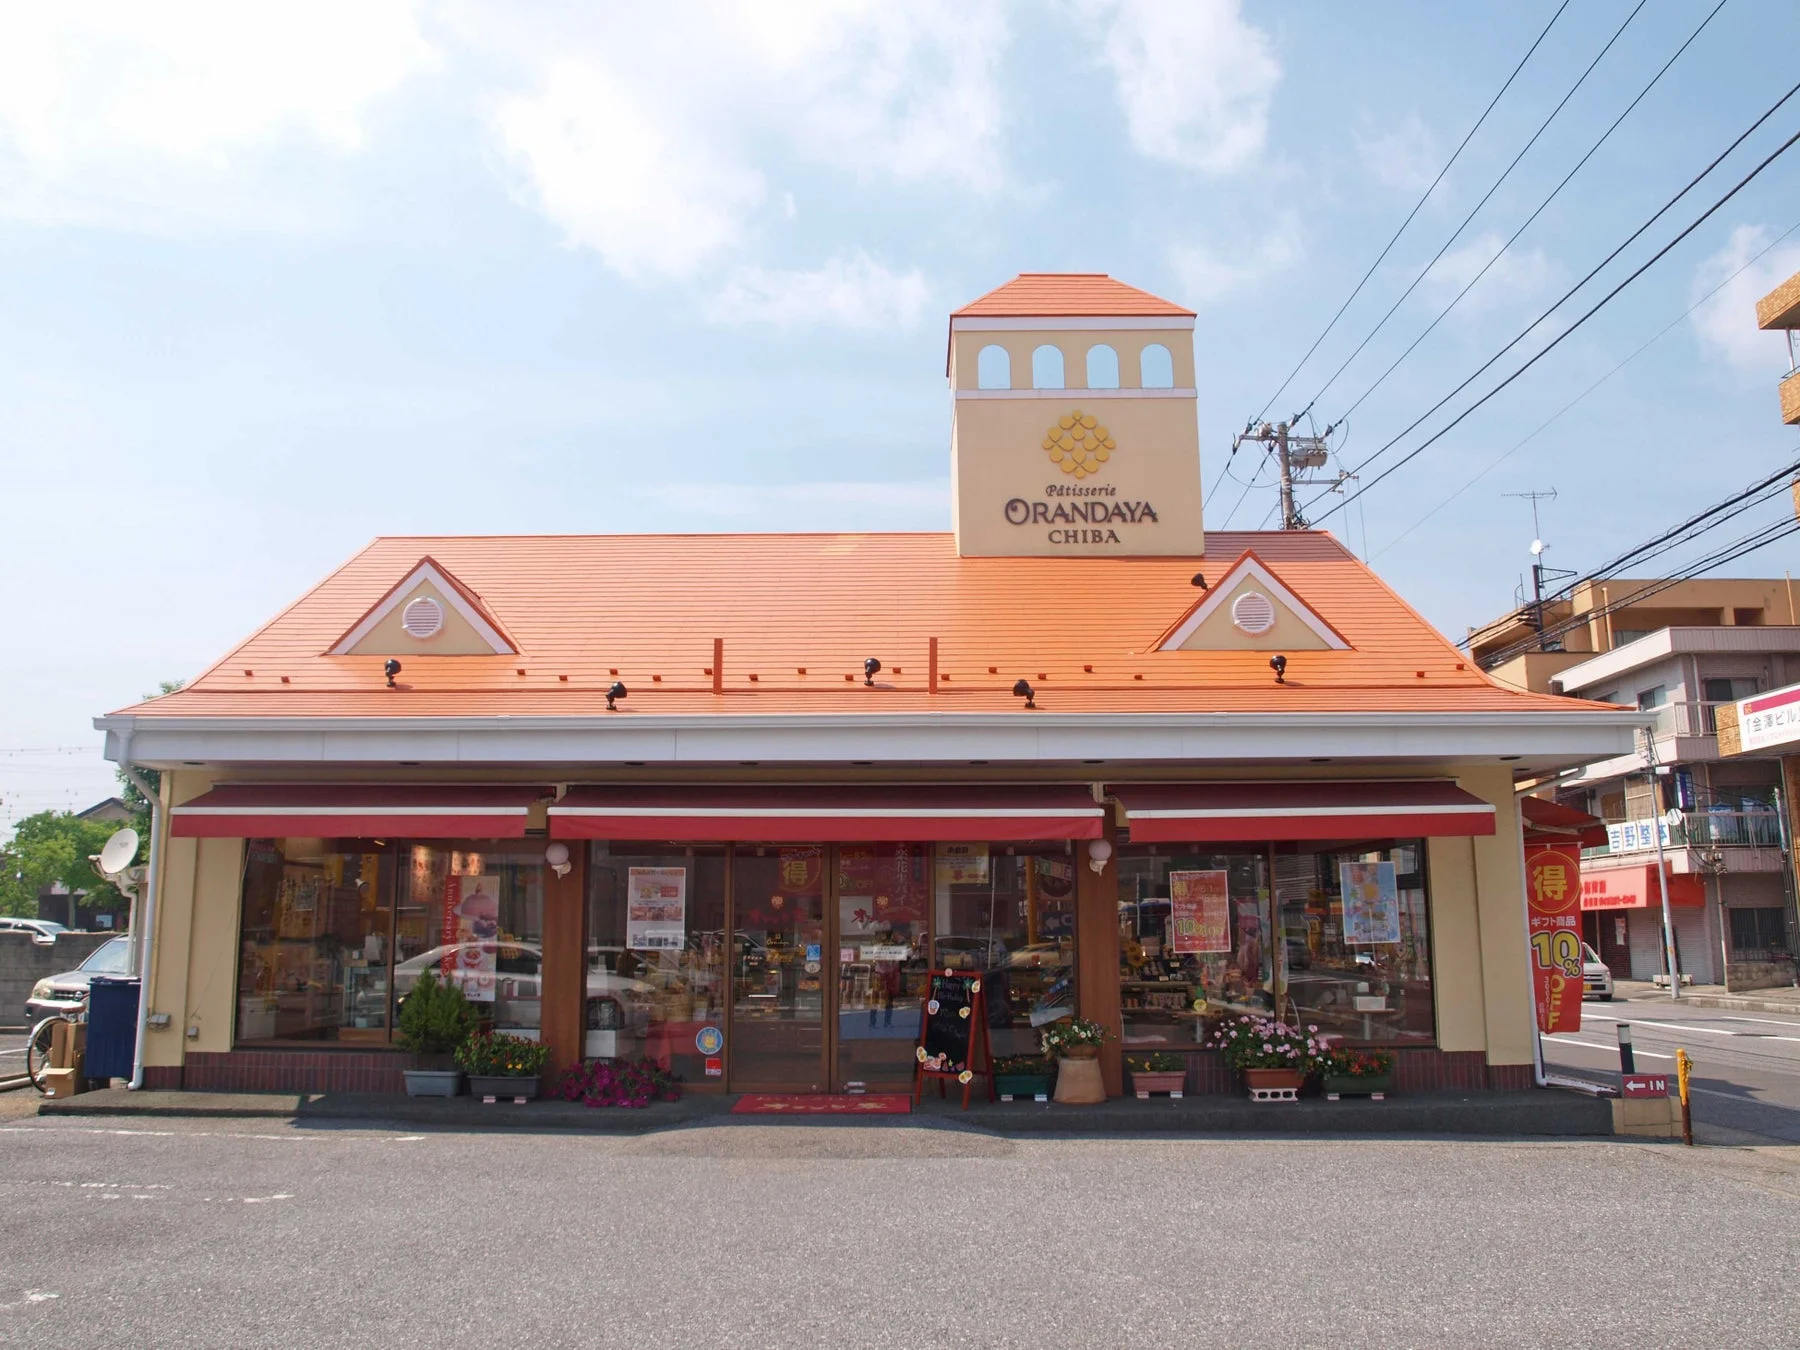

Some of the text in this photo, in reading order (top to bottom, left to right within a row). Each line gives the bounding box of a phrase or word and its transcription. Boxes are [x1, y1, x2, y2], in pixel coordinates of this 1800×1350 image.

[1045, 483, 1117, 497] Pâtisserie
[1004, 497, 1158, 525] ORANDAYA
[1048, 529, 1121, 544] CHIBA
[782, 860, 808, 886] 得
[1532, 865, 1568, 901] 得
[1531, 915, 1576, 927] ギフト商品
[1649, 1080, 1665, 1091] IN
